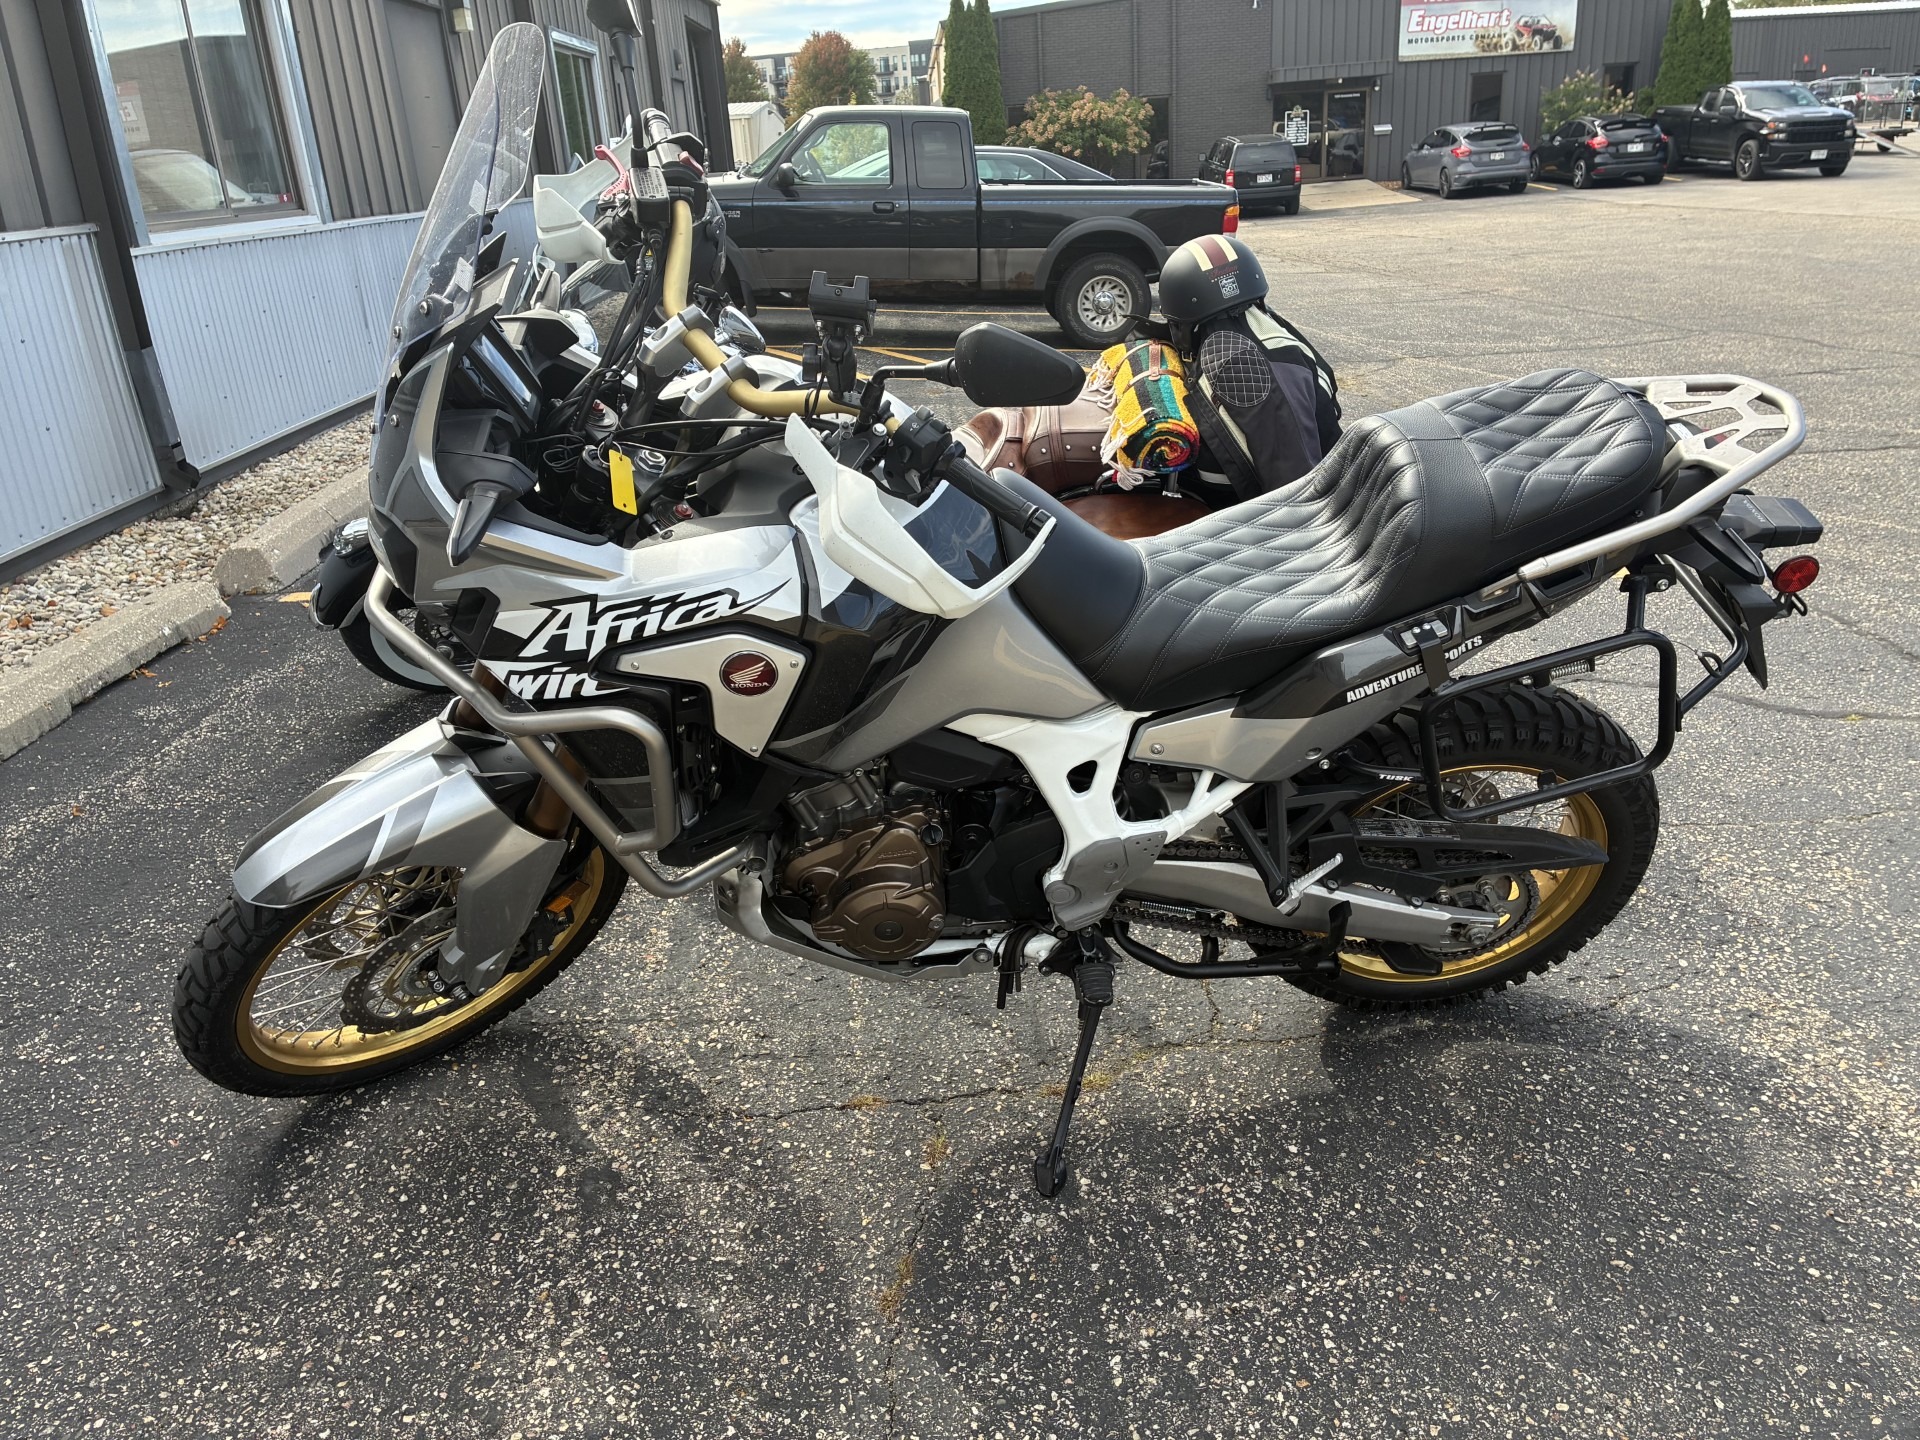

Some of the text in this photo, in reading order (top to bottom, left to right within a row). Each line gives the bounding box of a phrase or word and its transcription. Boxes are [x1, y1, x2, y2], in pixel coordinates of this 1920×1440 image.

[1407, 8, 1511, 35] Engelhart
[1407, 35, 1466, 44] MOTORSPORTS
[1222, 283, 1239, 294] DOT
[518, 590, 757, 662] Africa
[1346, 635, 1483, 703] ADVENTURE PORTS
[1379, 773, 1414, 782] TUSK
